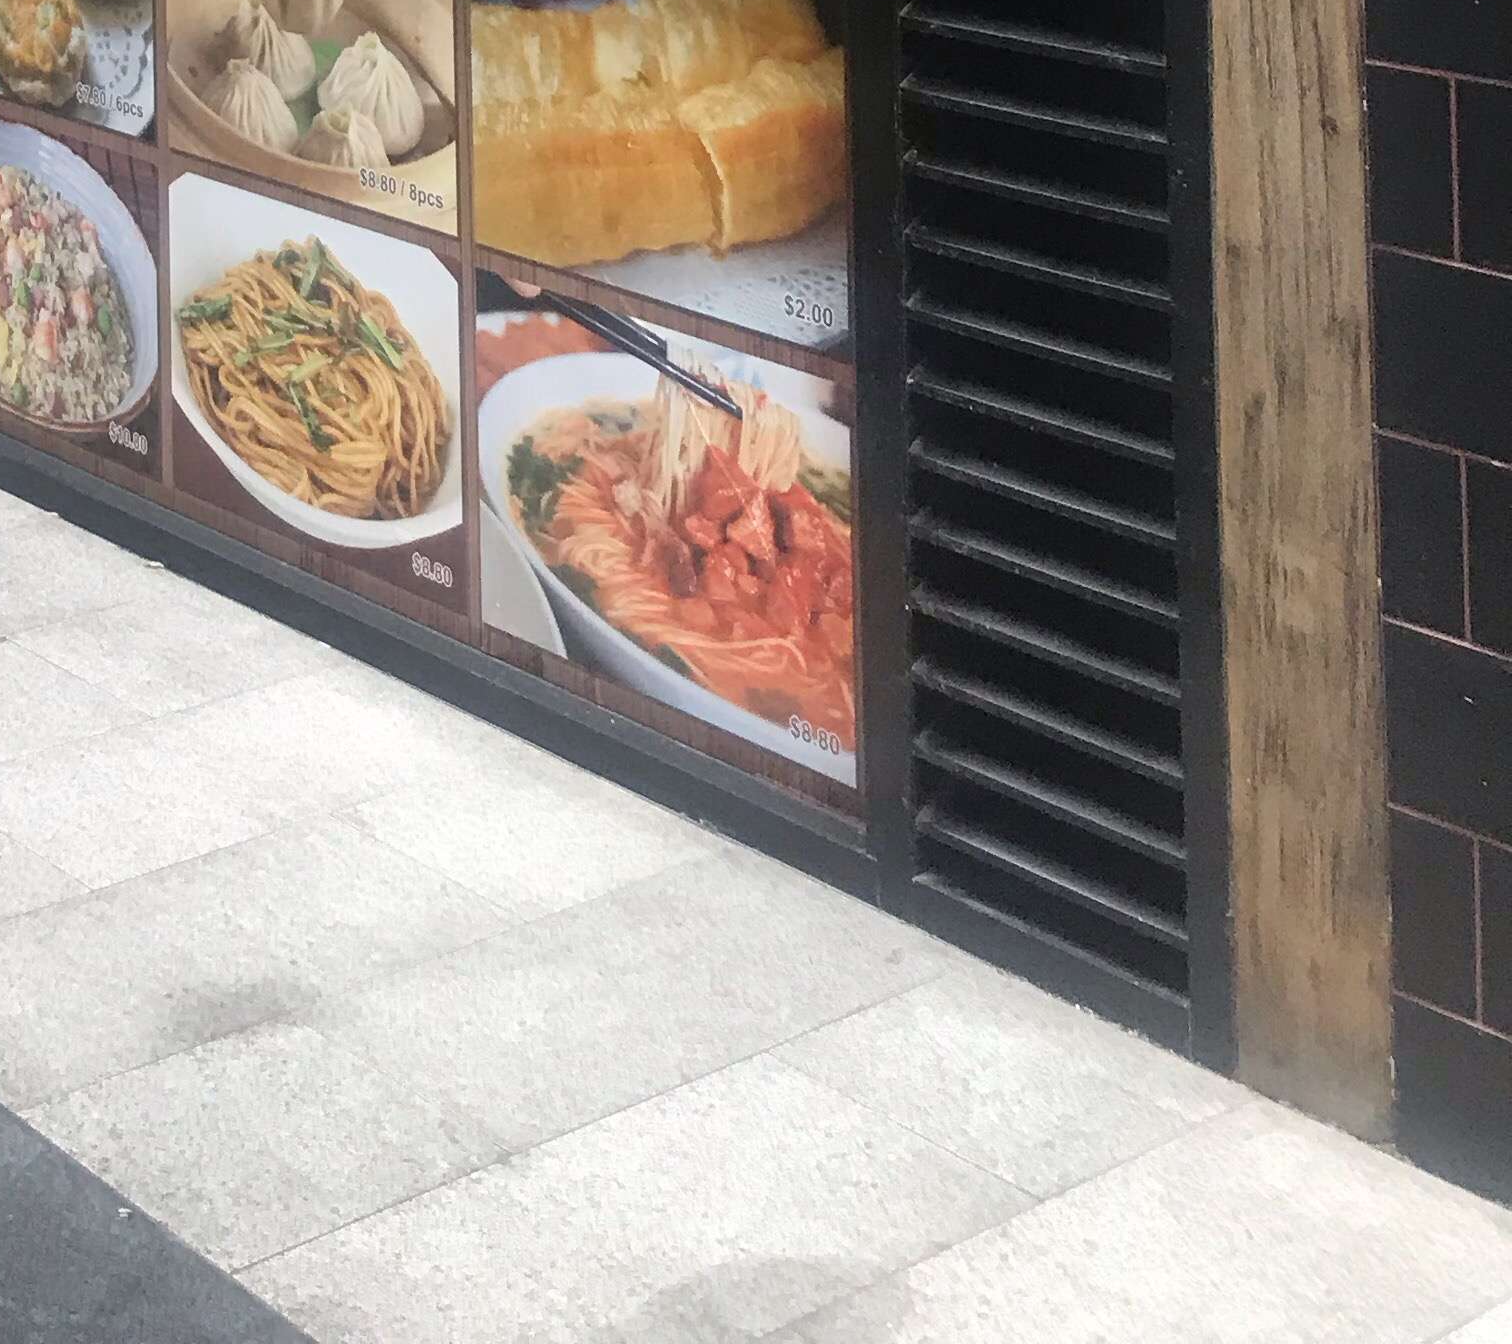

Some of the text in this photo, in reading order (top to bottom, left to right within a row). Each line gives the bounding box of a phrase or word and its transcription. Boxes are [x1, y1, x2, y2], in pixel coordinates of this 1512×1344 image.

[115, 95, 144, 118] 6pcs
[359, 167, 397, 195] $8.80
[408, 183, 445, 210] 8pcs
[783, 293, 834, 328] $2.00
[411, 551, 454, 588] $8.80
[788, 714, 841, 756] $8.80
